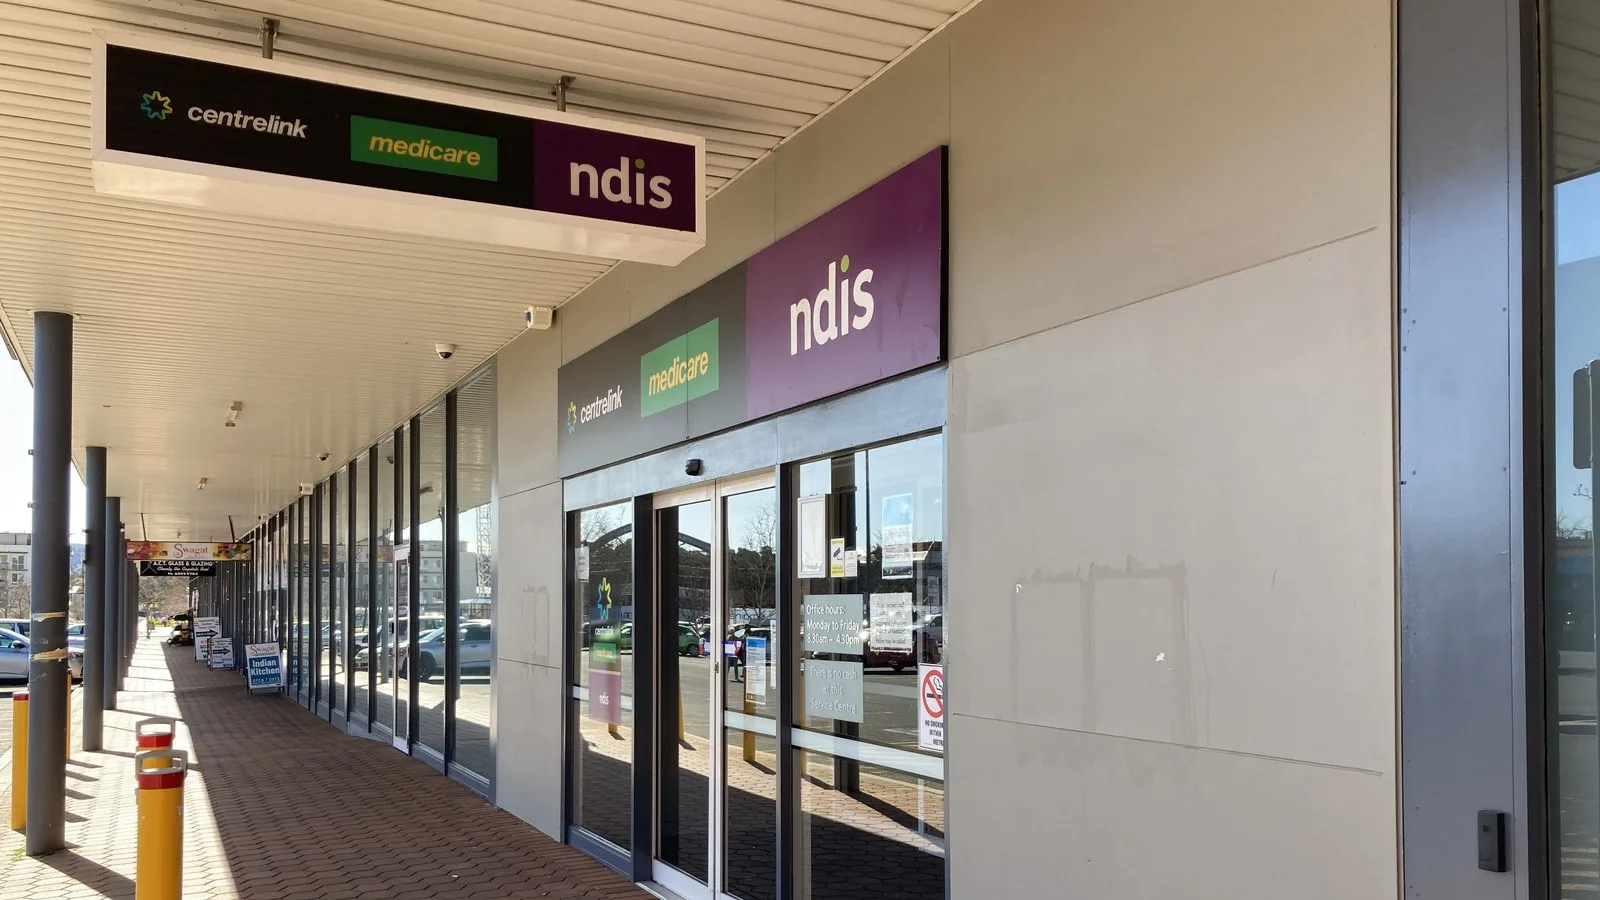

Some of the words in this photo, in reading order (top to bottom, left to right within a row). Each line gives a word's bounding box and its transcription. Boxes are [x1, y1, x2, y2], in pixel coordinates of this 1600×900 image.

[187, 105, 308, 139] centrelink
[369, 132, 481, 167] medicare
[569, 156, 673, 210] ndis
[790, 254, 875, 356] ndis
[648, 349, 709, 396] medicare
[580, 384, 624, 424] centrelink
[174, 543, 208, 559] Swagat
[806, 604, 824, 615] Office
[825, 605, 845, 615] hours:
[594, 625, 615, 636] centrelink
[806, 619, 831, 633] Monday
[832, 621, 839, 631] to
[840, 620, 860, 634] Friday
[835, 634, 860, 647] 4.30pm
[250, 644, 275, 657] Swagat
[252, 658, 277, 668] Indian
[250, 667, 280, 676] Kitchen
[809, 665, 827, 677] There
[827, 668, 832, 678] is
[833, 669, 842, 678] no
[842, 668, 857, 680] cash
[823, 684, 830, 694] at
[831, 684, 843, 695] this
[599, 691, 609, 705] ndis
[811, 697, 833, 710] Service
[834, 700, 856, 714] Centre
[924, 719, 930, 727] NO
